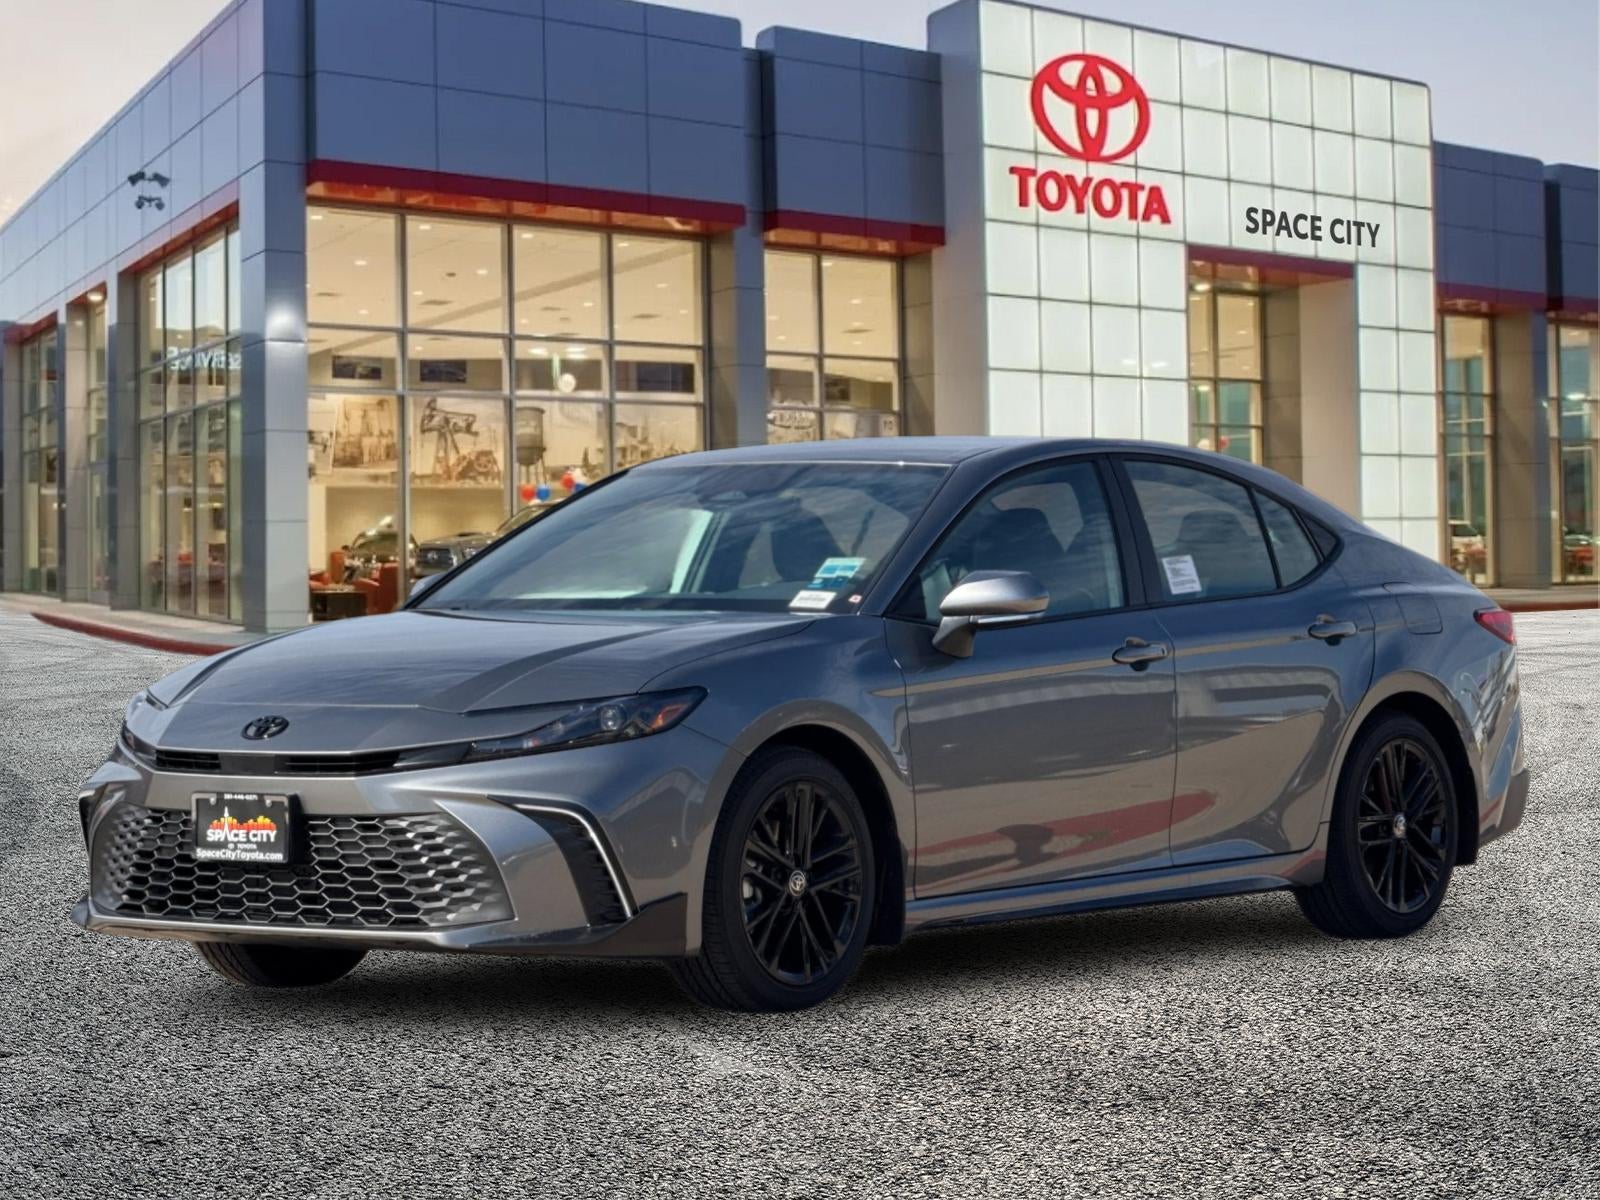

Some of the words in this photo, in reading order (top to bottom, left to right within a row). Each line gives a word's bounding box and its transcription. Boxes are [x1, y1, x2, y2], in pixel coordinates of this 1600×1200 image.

[1009, 166, 1171, 225] TOYOTA
[1245, 207, 1323, 241] SPACE
[1329, 218, 1380, 248] CITY
[206, 828, 247, 842] SPACE
[248, 829, 277, 842] CITY
[196, 848, 283, 861] SpaceCityToyota.com
